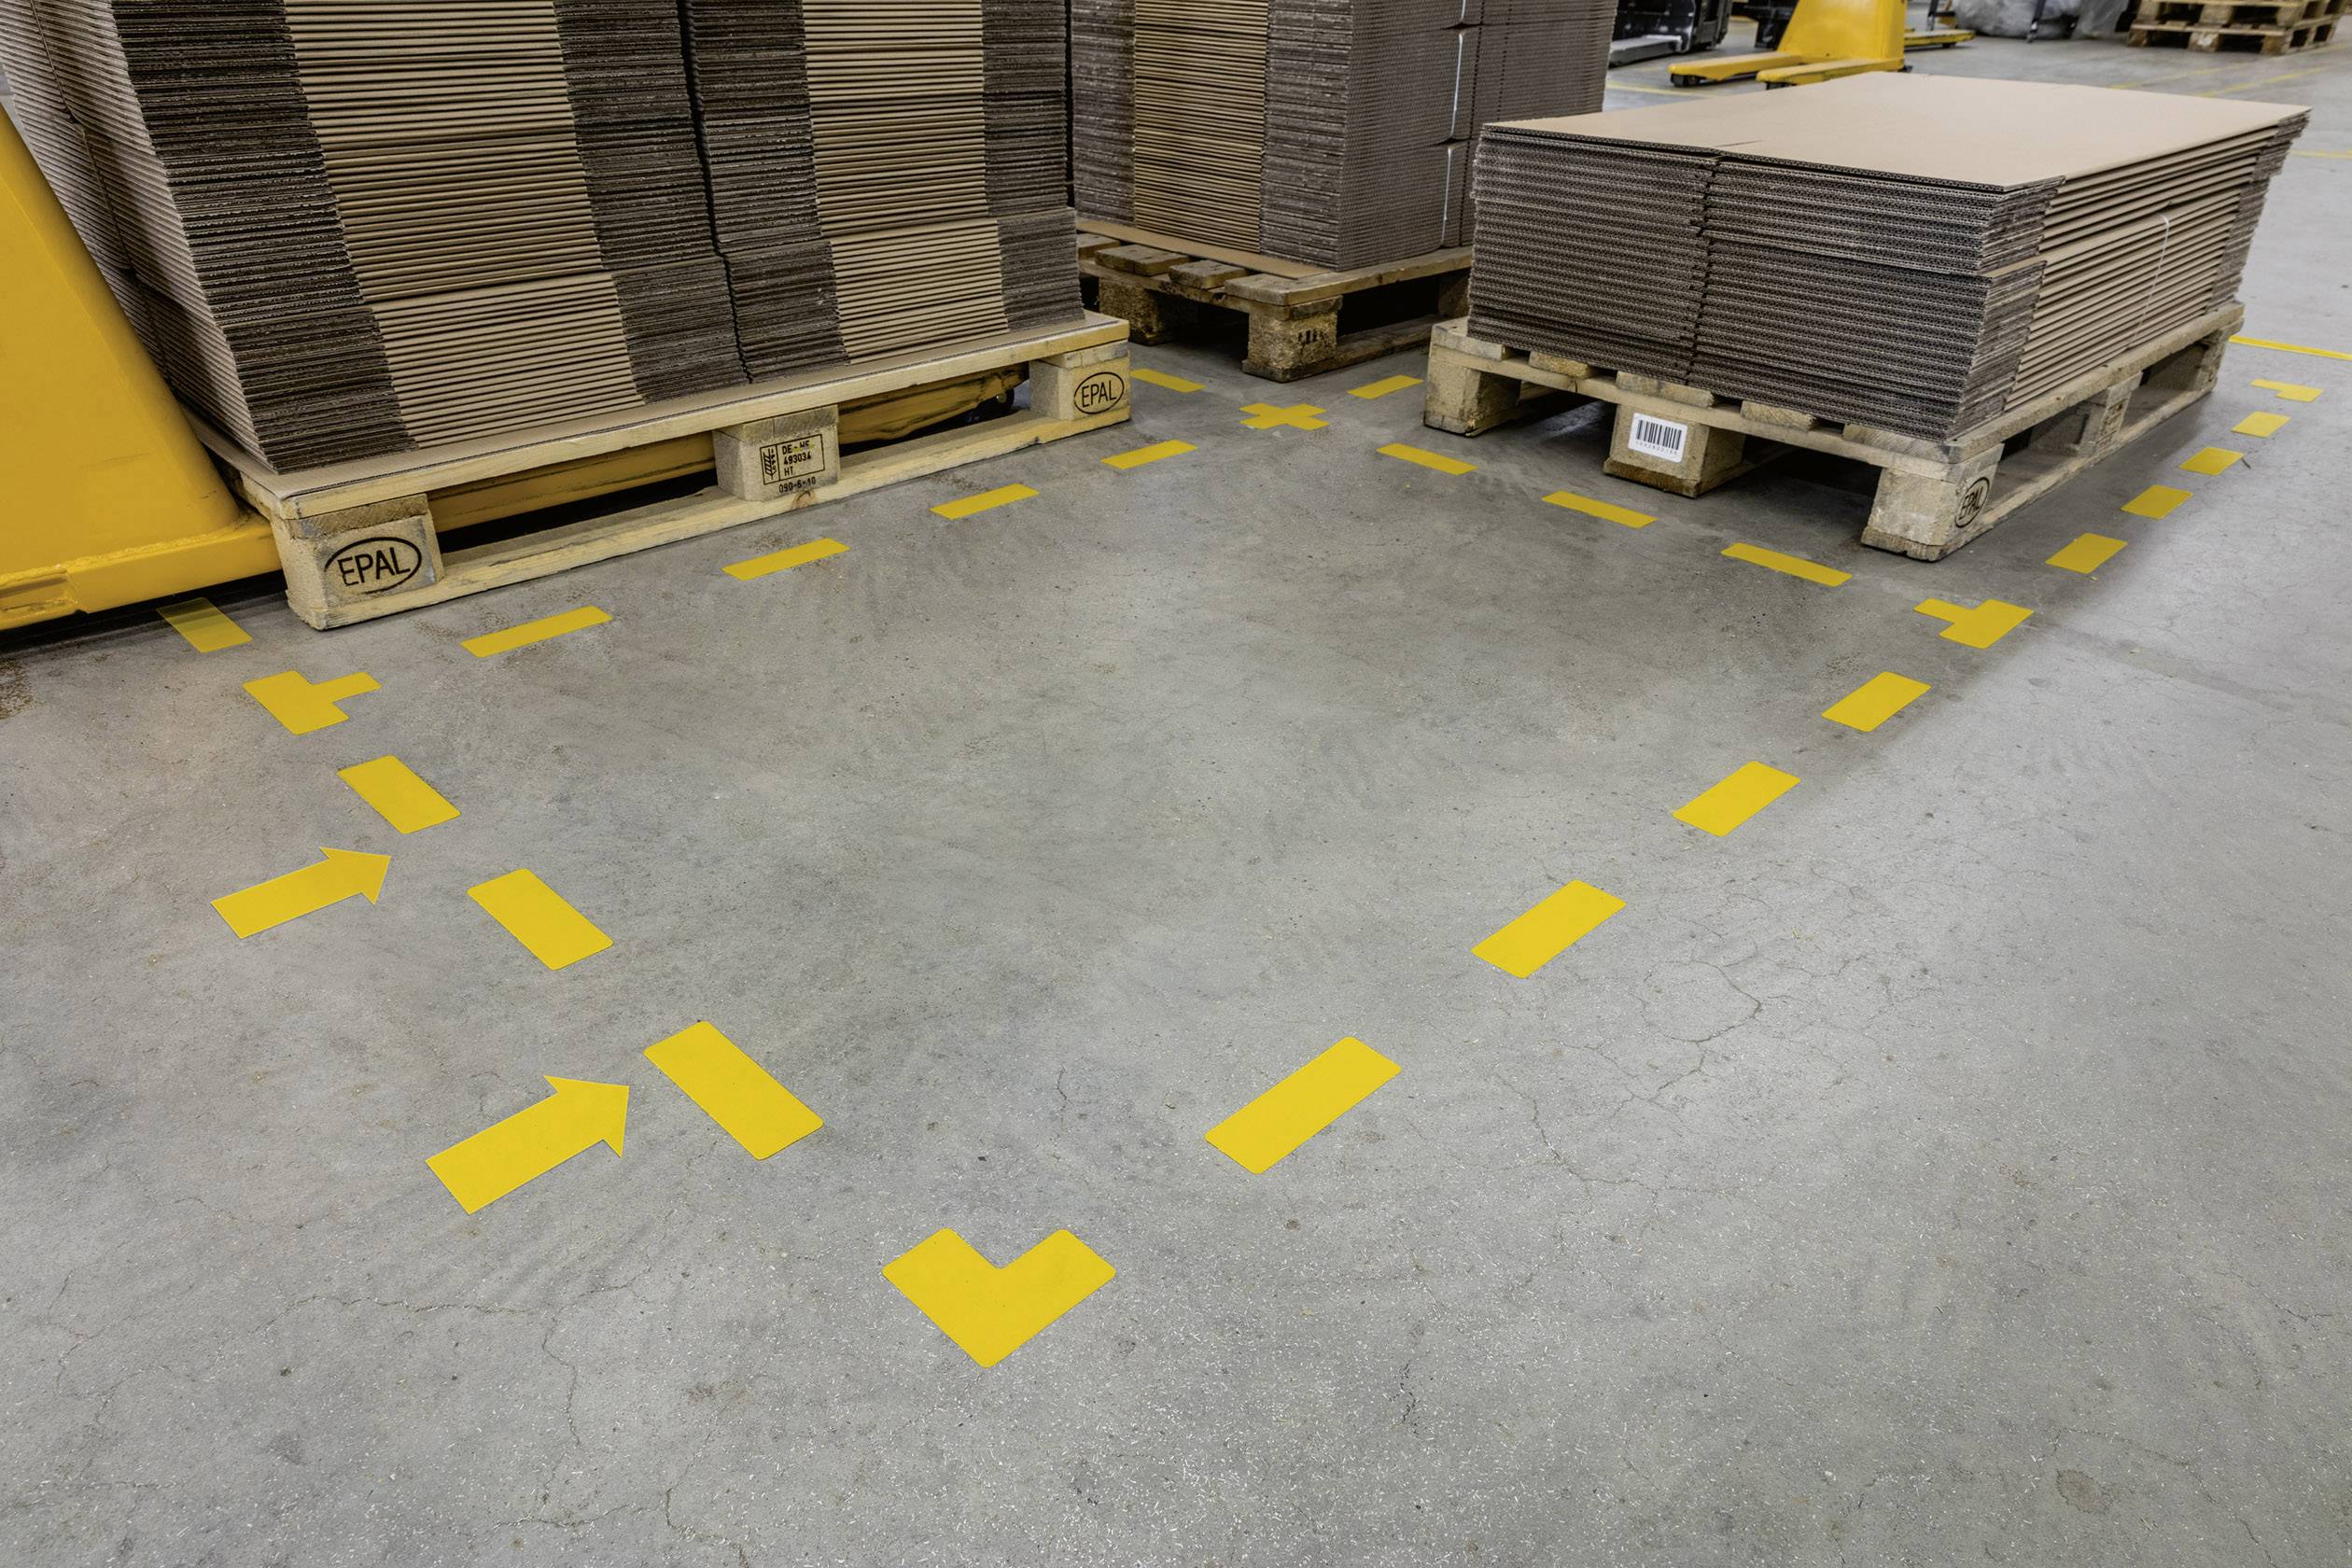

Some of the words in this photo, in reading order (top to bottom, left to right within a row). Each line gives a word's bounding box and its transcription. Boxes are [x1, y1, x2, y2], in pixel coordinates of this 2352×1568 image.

[1081, 380, 1117, 408] EPAL
[784, 452, 811, 465] 493034
[784, 466, 794, 477] HT
[1958, 486, 1983, 520] EPAL
[337, 547, 411, 586] EPAL
